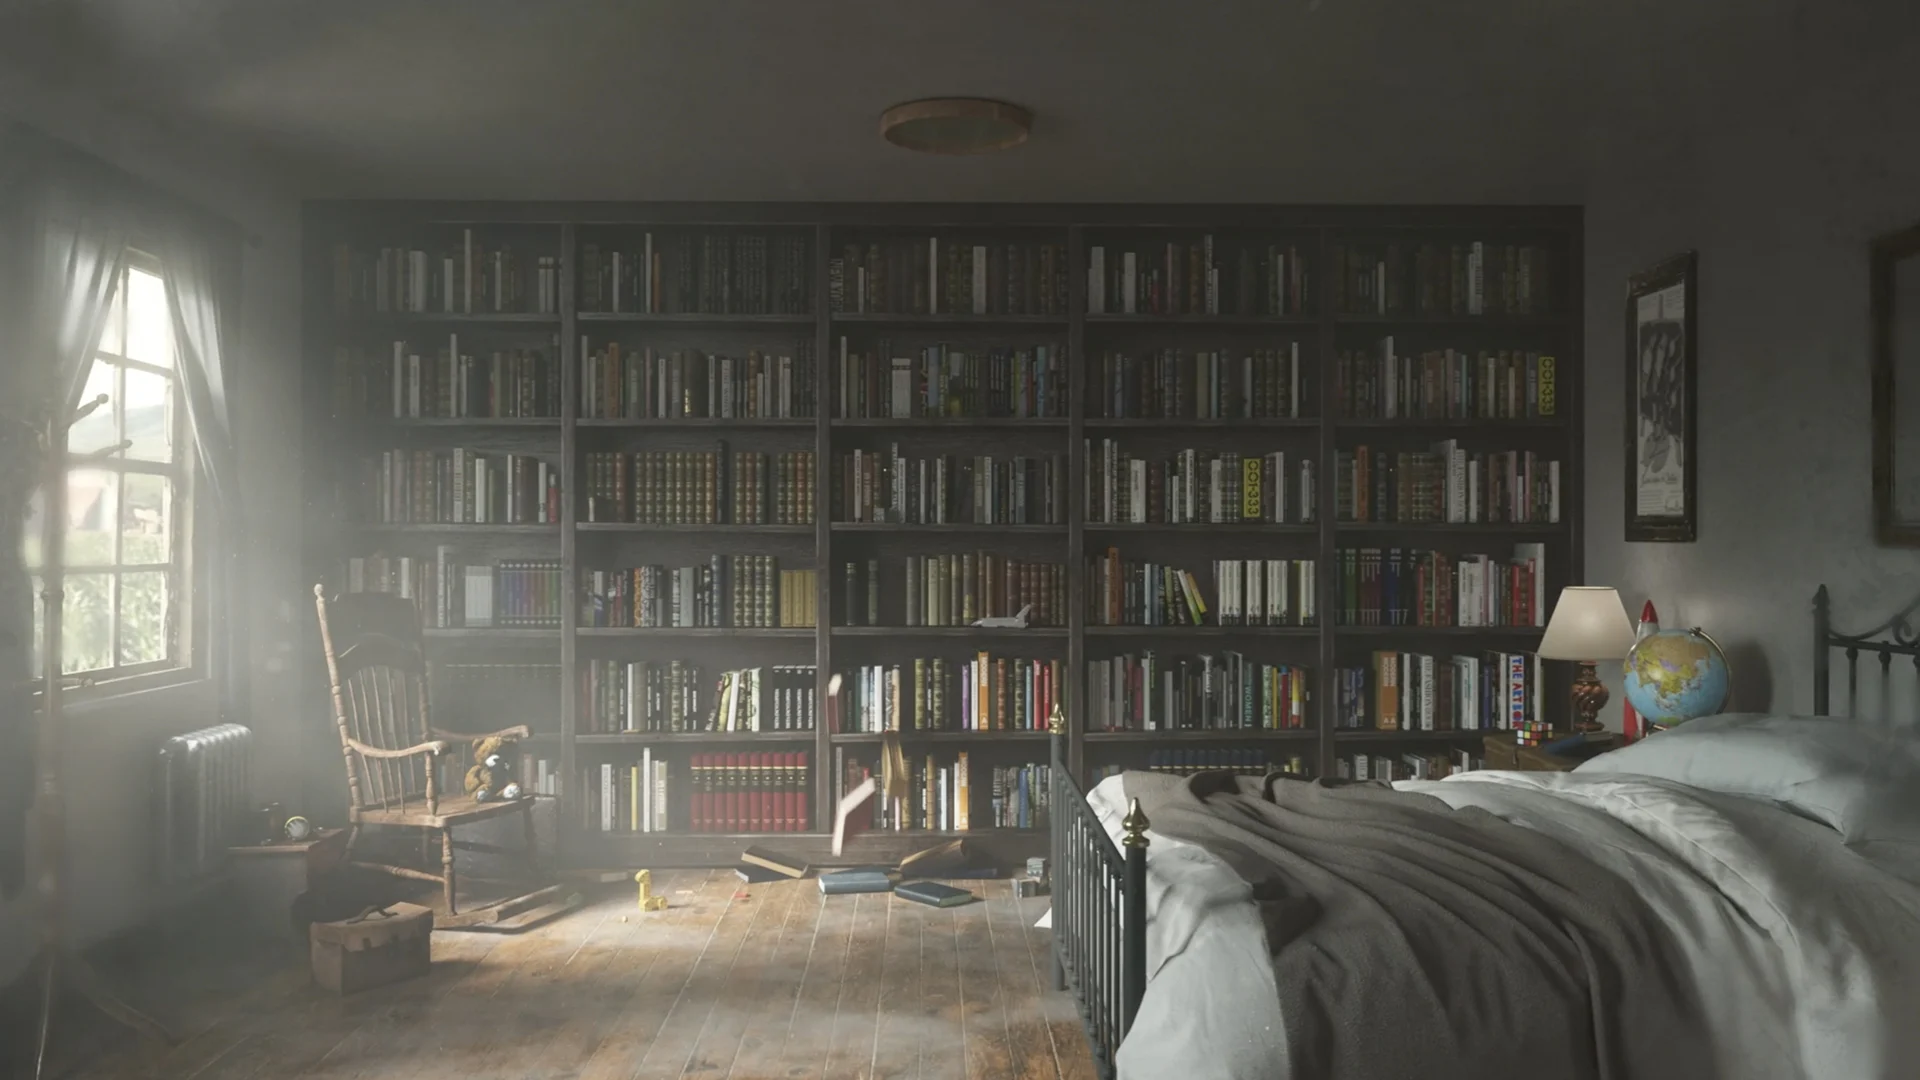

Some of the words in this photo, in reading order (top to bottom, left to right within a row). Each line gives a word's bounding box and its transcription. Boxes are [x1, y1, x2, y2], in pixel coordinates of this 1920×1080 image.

[1512, 657, 1523, 679] THE
[1512, 682, 1523, 703] ART
[1244, 686, 1252, 722] WOMEN
